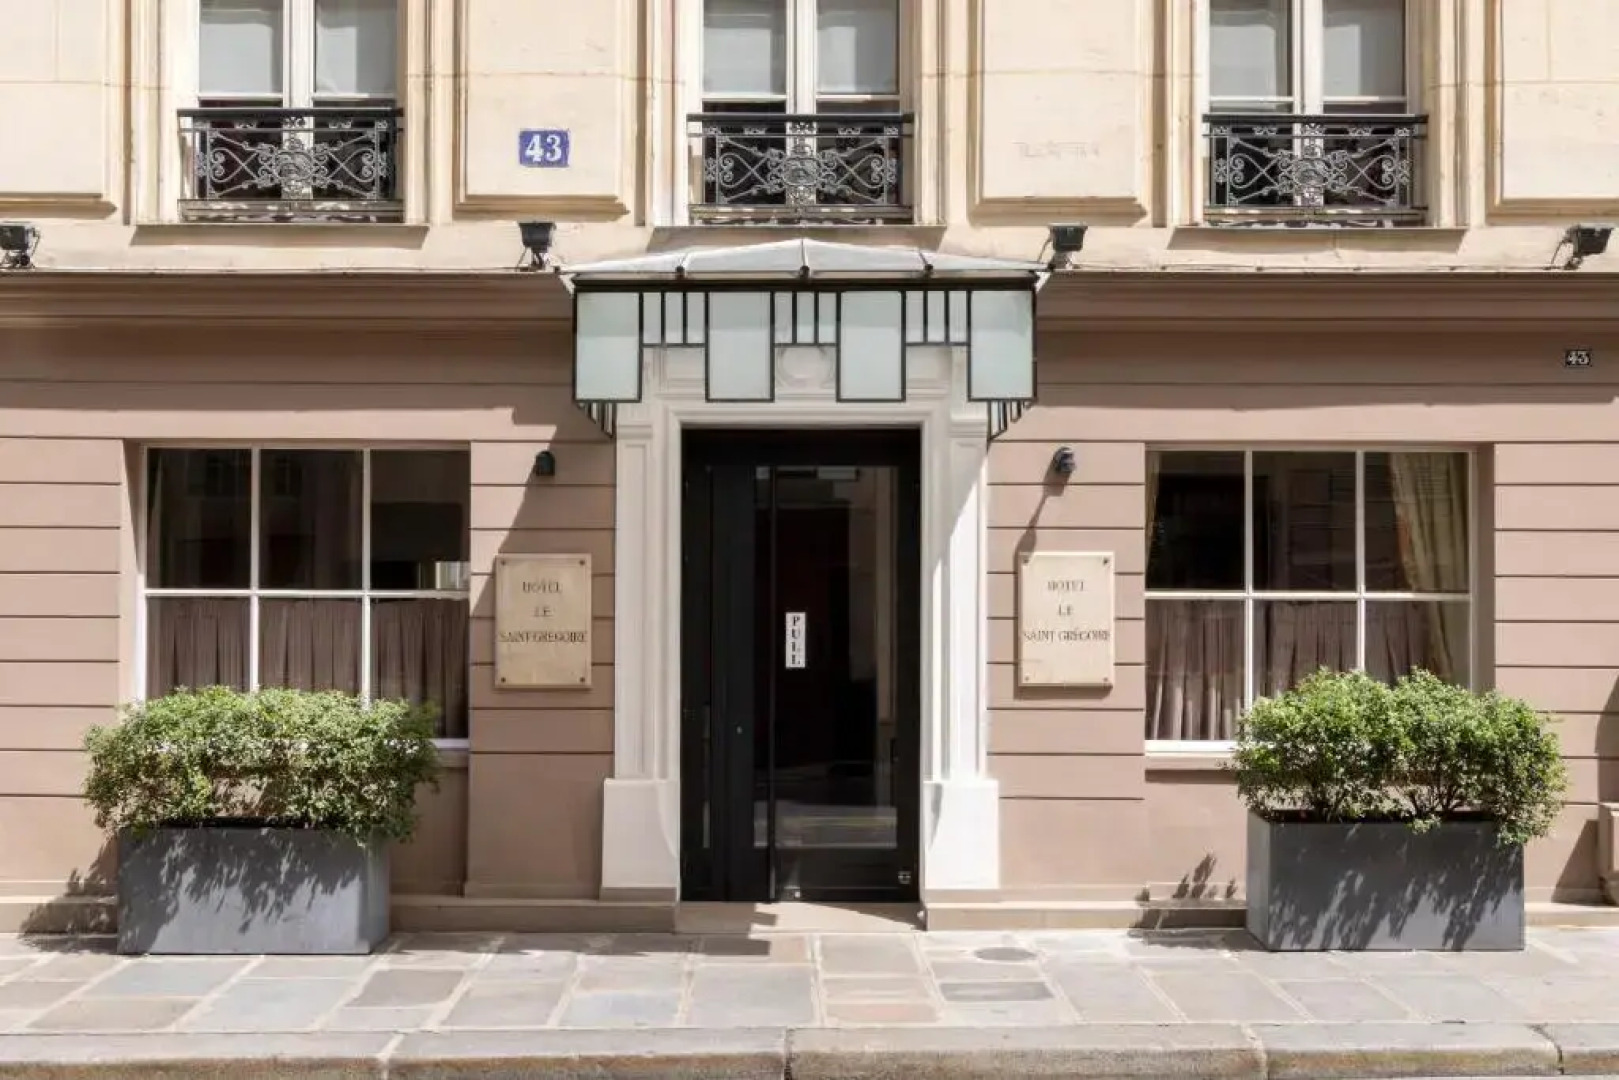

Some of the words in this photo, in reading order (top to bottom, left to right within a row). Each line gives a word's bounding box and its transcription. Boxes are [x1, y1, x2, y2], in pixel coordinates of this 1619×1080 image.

[524, 133, 562, 162] 43
[1568, 350, 1590, 365] 43
[534, 606, 553, 618] LE
[1057, 603, 1075, 617] LE
[500, 630, 532, 643] SAINT
[791, 615, 802, 666] PULL
[1023, 630, 1055, 642] SAINT
